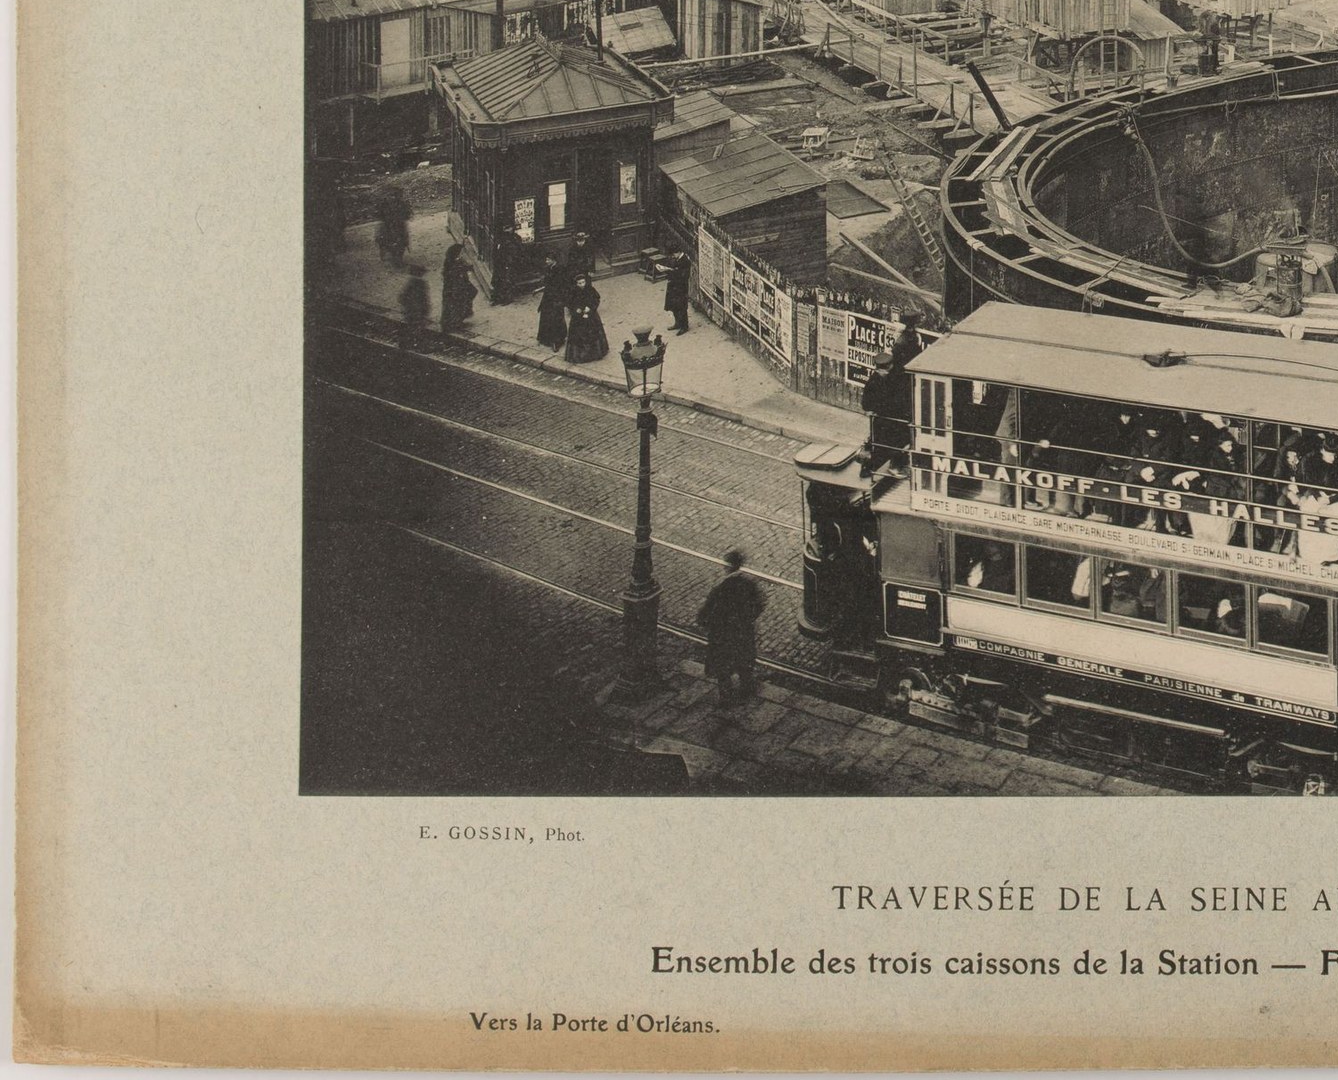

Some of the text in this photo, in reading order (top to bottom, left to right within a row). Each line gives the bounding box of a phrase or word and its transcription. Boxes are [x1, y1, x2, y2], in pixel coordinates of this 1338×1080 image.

[848, 316, 876, 345] PLACE
[848, 348, 876, 366] EXPOSITIO
[932, 456, 1094, 494] MALAKOFF
[1120, 484, 1182, 510] LES
[924, 498, 950, 512] PORTE
[1128, 534, 1178, 552] BOULEVARD
[1236, 552, 1265, 566] PLACE
[1278, 561, 1314, 576] MICHEL
[978, 641, 1044, 662] COMPAGNIE
[1144, 674, 1222, 698] PARISIENNE
[1232, 693, 1245, 704] de
[1255, 696, 1330, 720] TRAMWAYS
[419, 825, 585, 845] E. GOSSIN, Phot.
[831, 879, 1035, 912] TRAVERSÉE
[1058, 886, 1101, 912] DE
[1125, 886, 1167, 912] LA
[1190, 886, 1287, 913] SEINE
[651, 946, 796, 975] Ensemble
[808, 948, 856, 975] des
[867, 951, 932, 975] trois
[944, 951, 1061, 976] caissons
[1073, 949, 1108, 976] de
[1119, 948, 1145, 975] la
[1157, 949, 1259, 976] Station
[469, 1012, 721, 1034] Vers la Porte d'Orléans.
